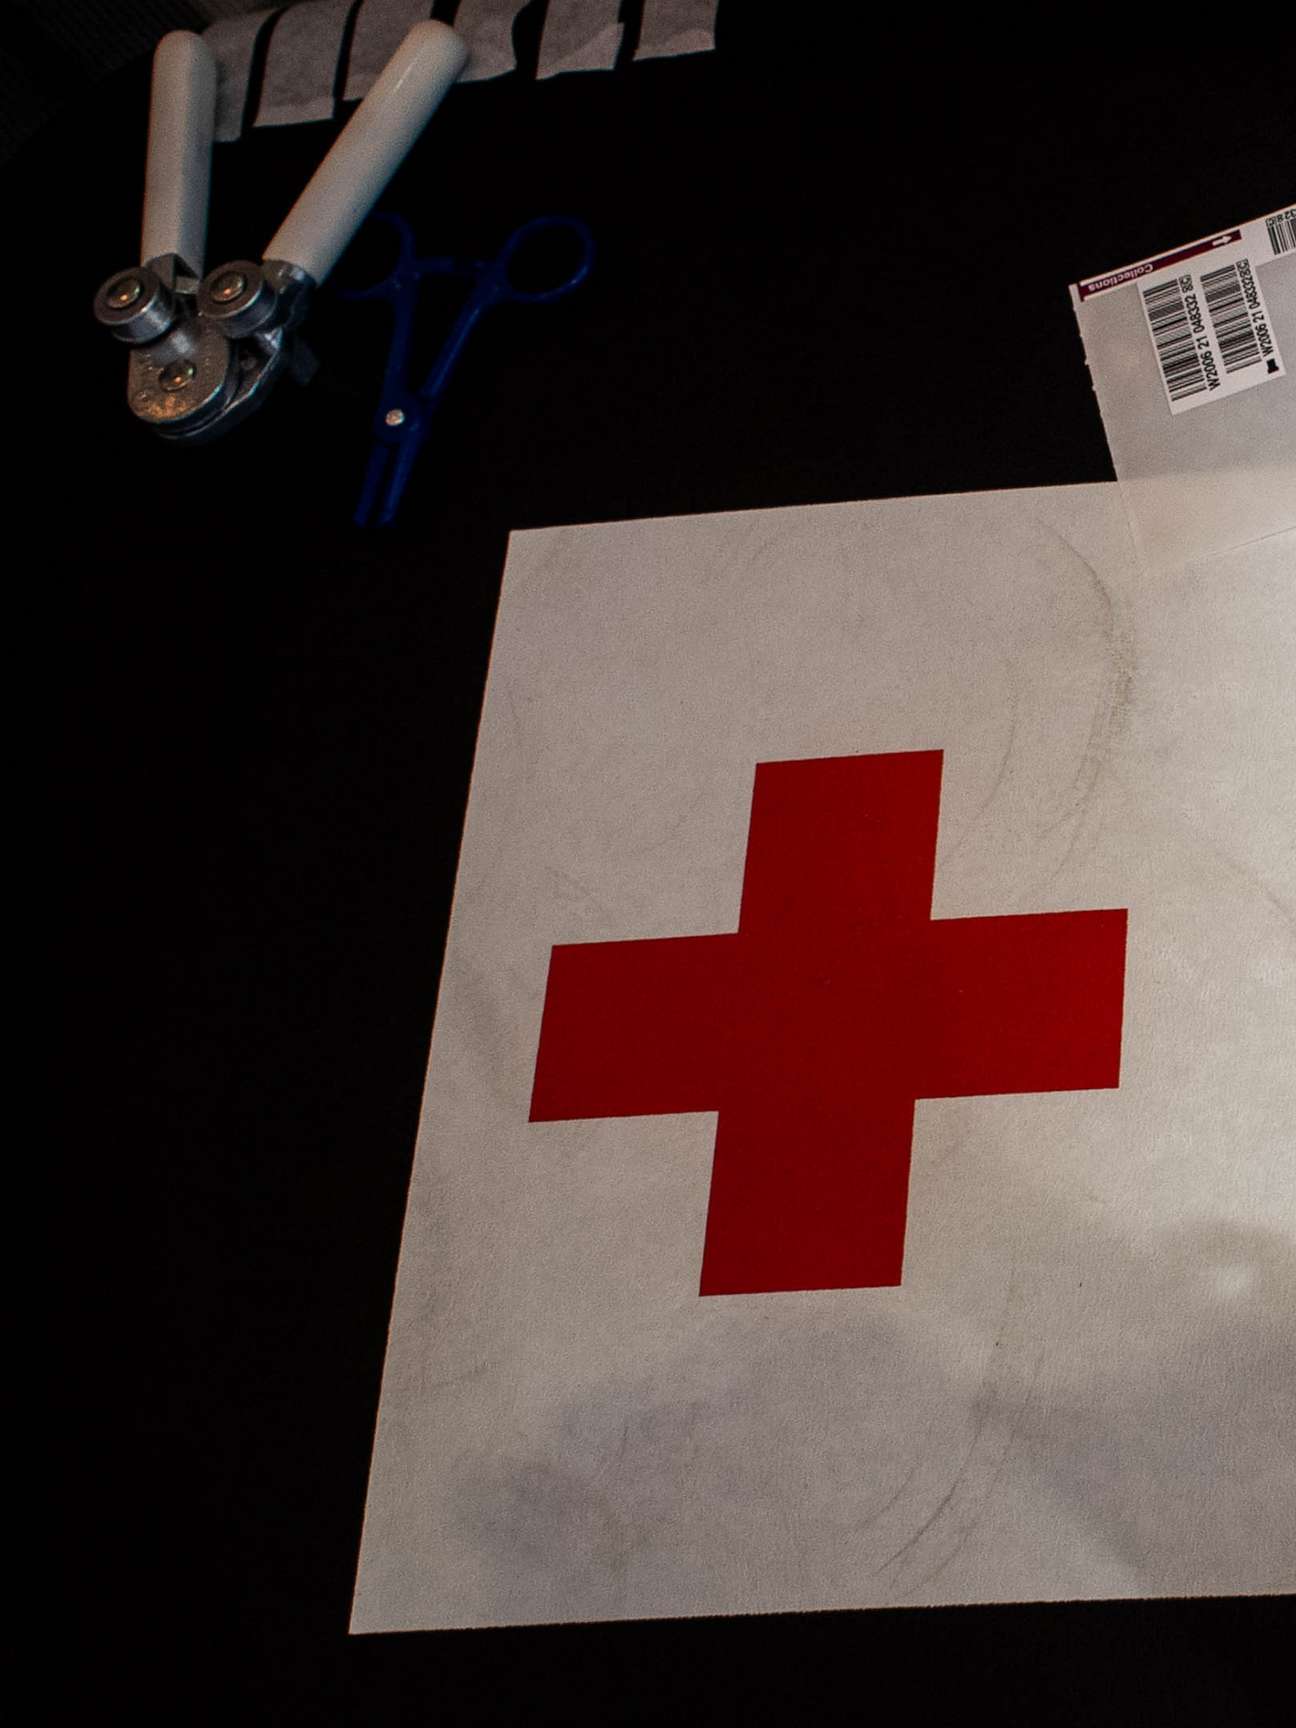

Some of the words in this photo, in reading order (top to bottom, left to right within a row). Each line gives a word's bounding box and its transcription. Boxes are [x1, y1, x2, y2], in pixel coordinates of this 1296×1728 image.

[1088, 263, 1154, 292] Collections
[1251, 311, 1265, 323] 21
[1196, 336, 1210, 350] 21
[1254, 323, 1274, 358] W2006
[1200, 350, 1221, 391] W2006
